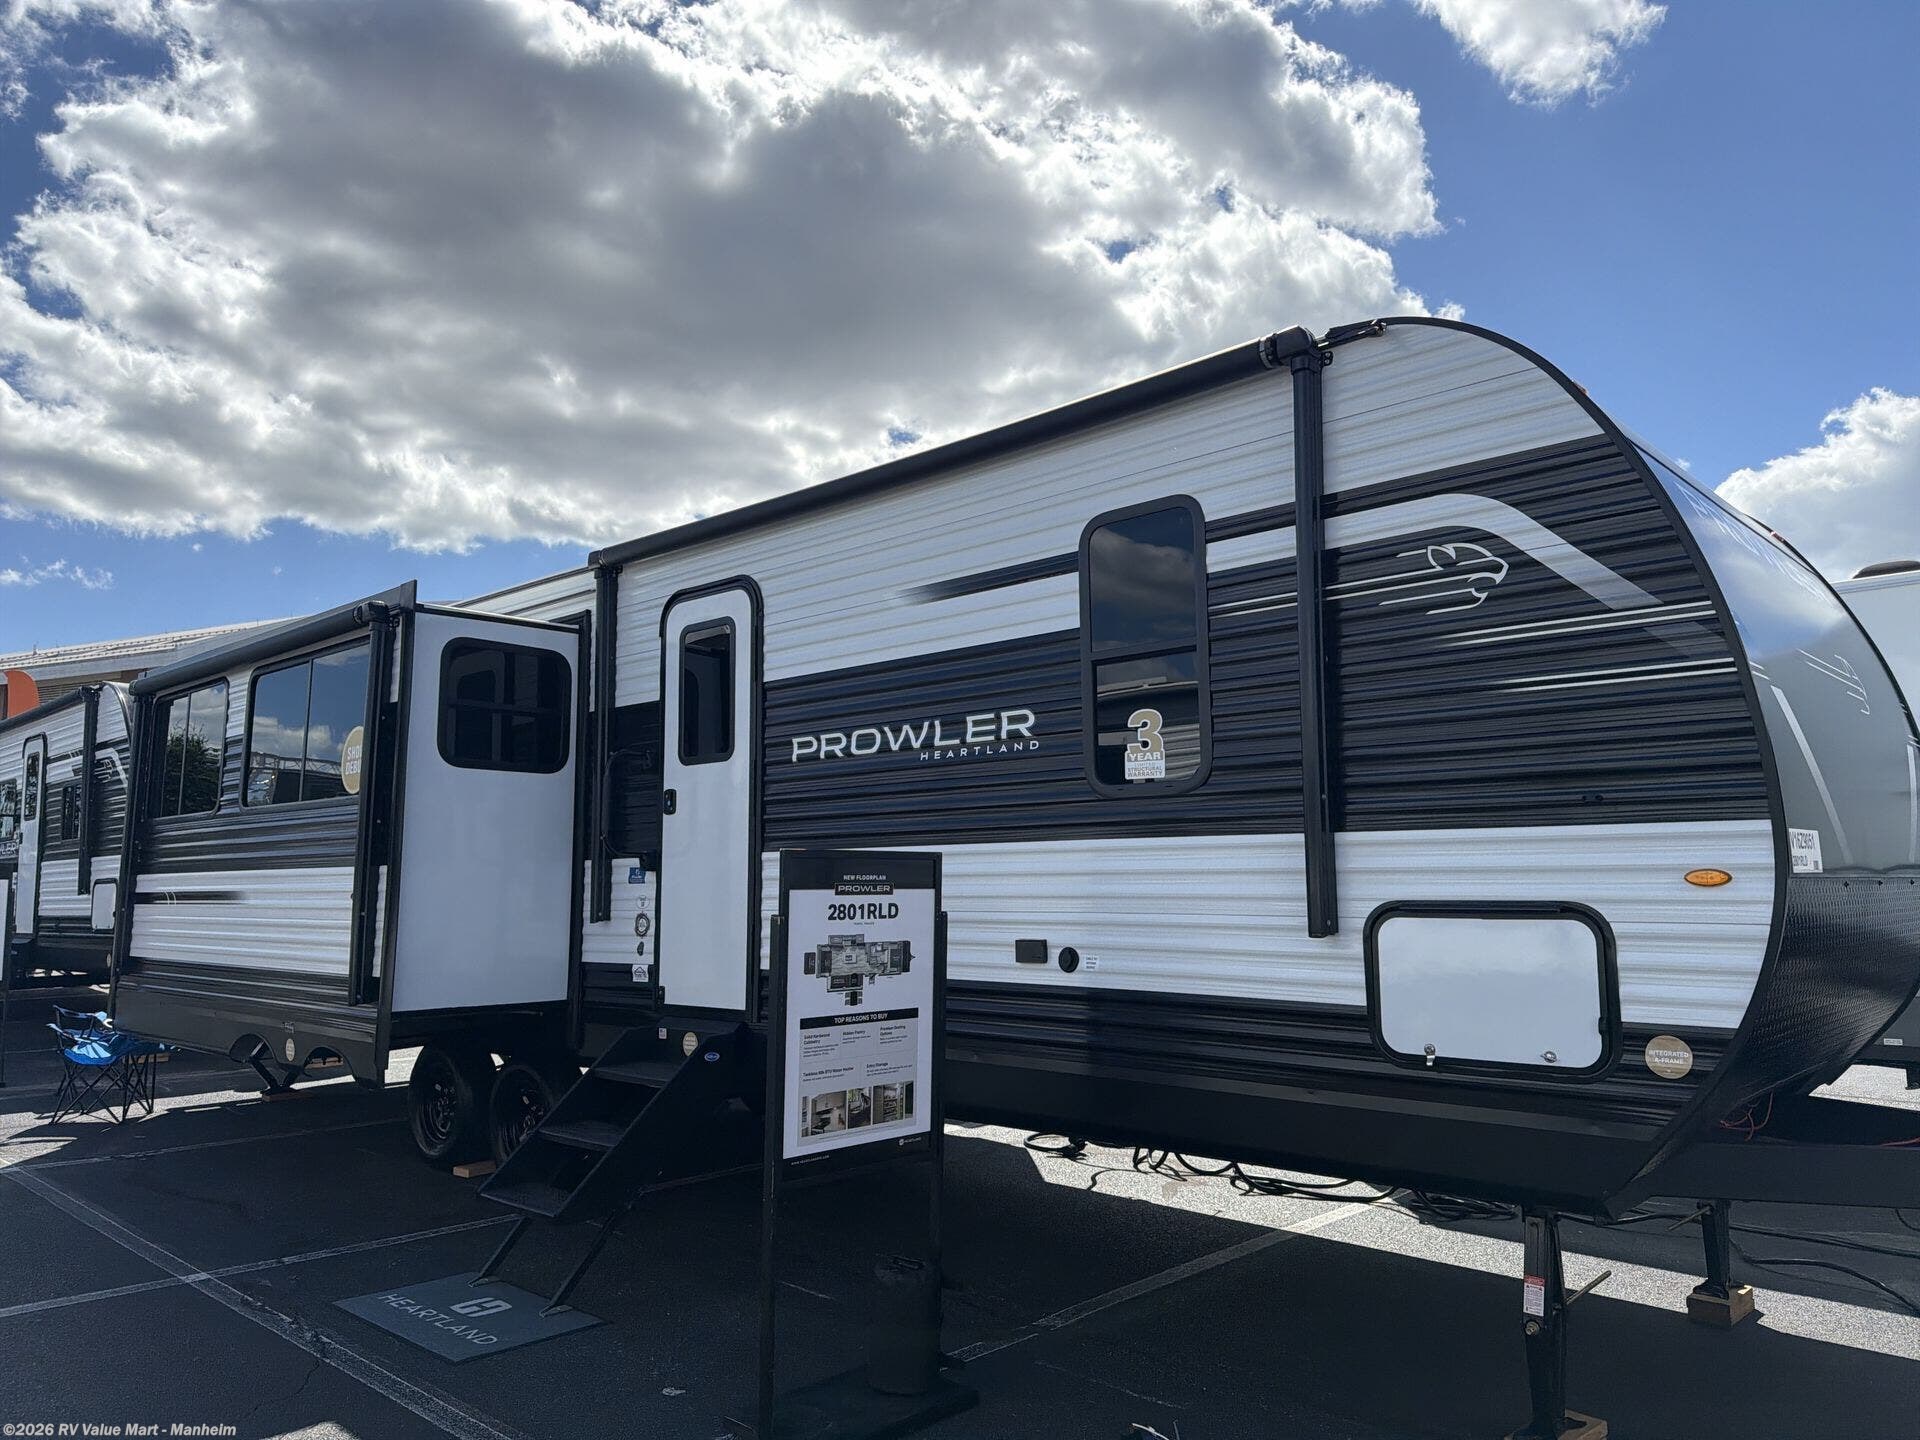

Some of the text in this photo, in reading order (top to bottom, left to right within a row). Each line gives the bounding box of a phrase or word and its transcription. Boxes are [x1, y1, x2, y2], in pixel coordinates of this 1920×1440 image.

[792, 709, 1036, 762] PROWLER
[1127, 708, 1163, 753] 3
[347, 745, 363, 760] SHO
[920, 741, 1040, 761] HEARTLAND
[1128, 751, 1162, 761] YEAR
[345, 759, 361, 775] DEBU
[1127, 770, 1164, 778] WARRANTY
[838, 885, 890, 893] PROWLER
[828, 903, 899, 920] 2801RLD
[846, 1015, 870, 1023] REASONS
[1648, 1049, 1689, 1058] INTEGRATED
[1654, 1057, 1684, 1065] A-FRAME
[378, 1293, 498, 1345] HEARTLAND
